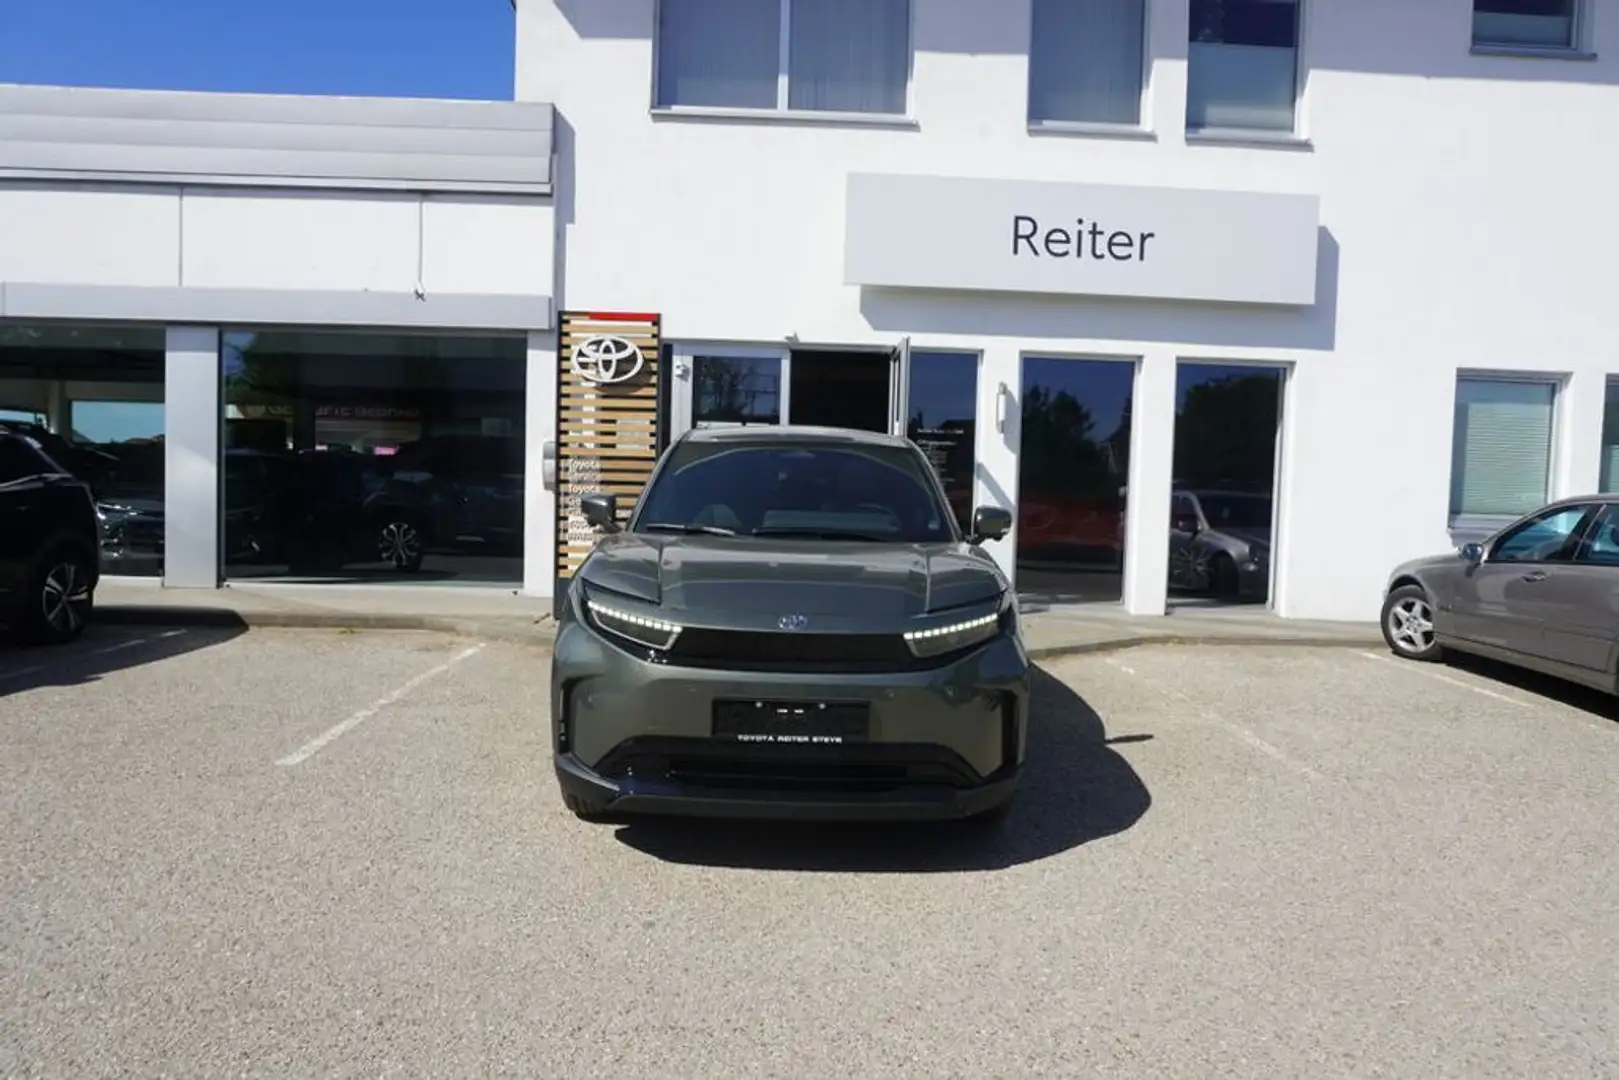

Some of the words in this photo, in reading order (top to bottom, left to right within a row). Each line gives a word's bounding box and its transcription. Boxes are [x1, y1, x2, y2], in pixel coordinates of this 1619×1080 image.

[1012, 215, 1155, 261] Reiter
[737, 734, 774, 742] TOYOTA
[777, 735, 809, 743] REITER
